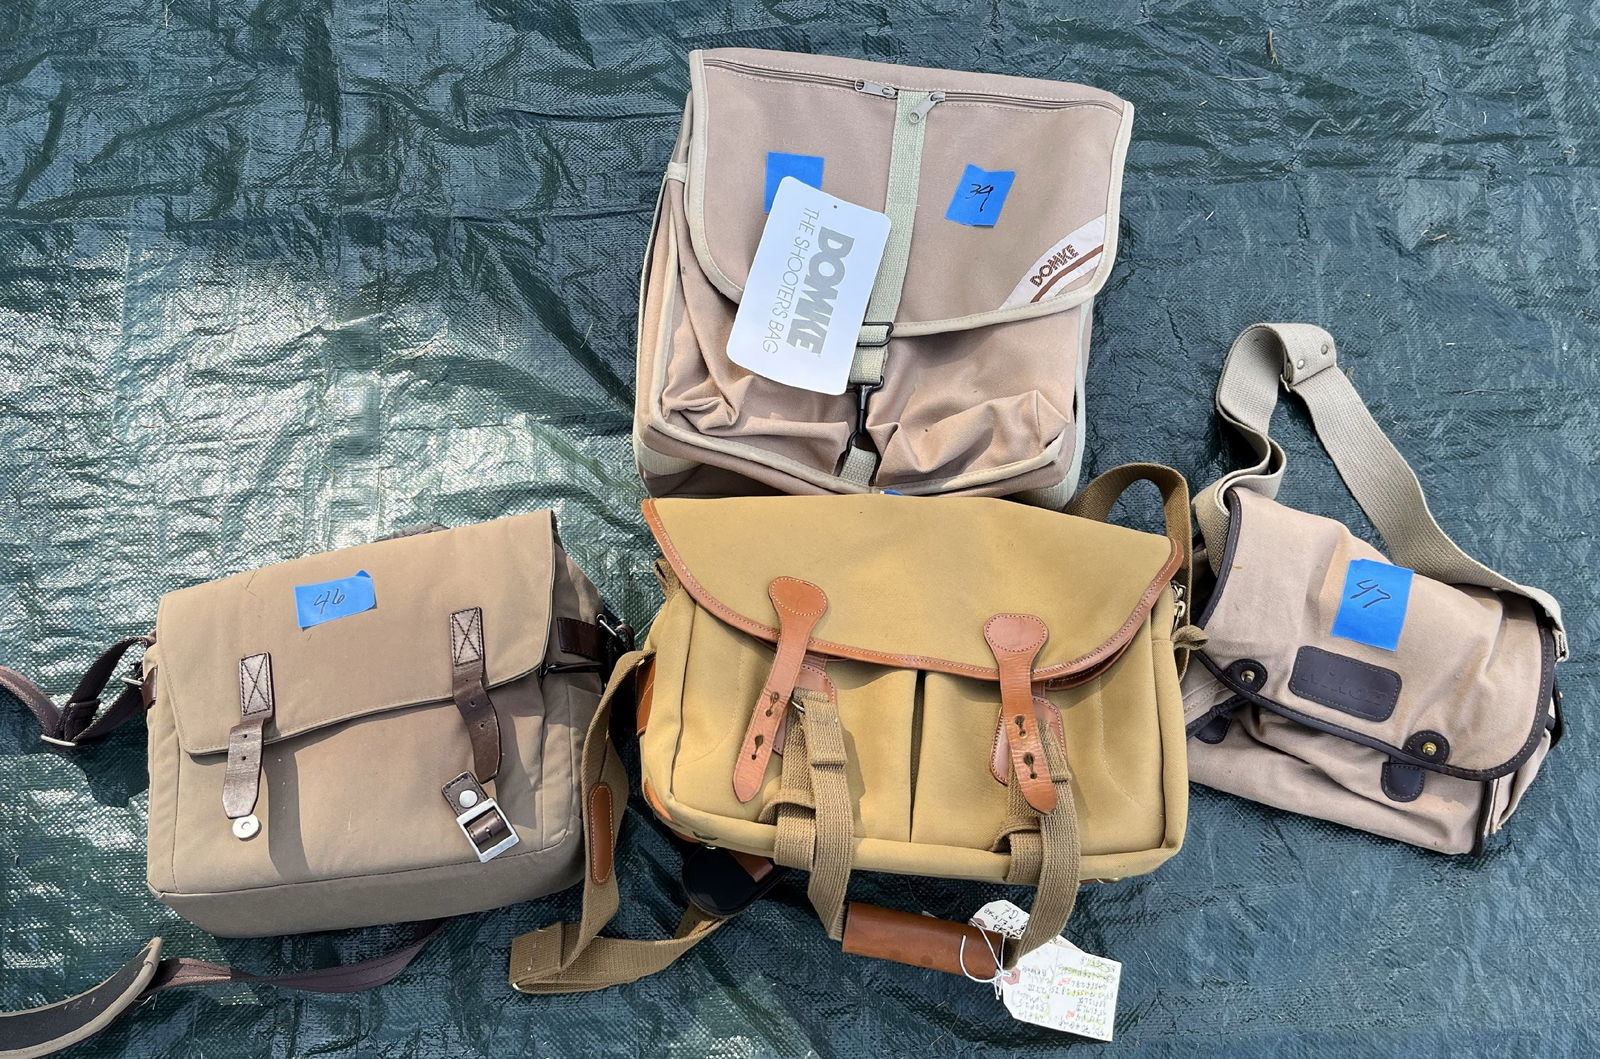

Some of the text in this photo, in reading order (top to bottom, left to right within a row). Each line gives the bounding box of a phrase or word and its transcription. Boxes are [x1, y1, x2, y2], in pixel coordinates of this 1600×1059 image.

[798, 207, 820, 236] THE
[1029, 243, 1080, 288] DOMKE
[786, 226, 856, 355] DOMKE
[762, 319, 785, 355] BAG
[313, 588, 346, 615] 46
[1350, 578, 1392, 609] 47
